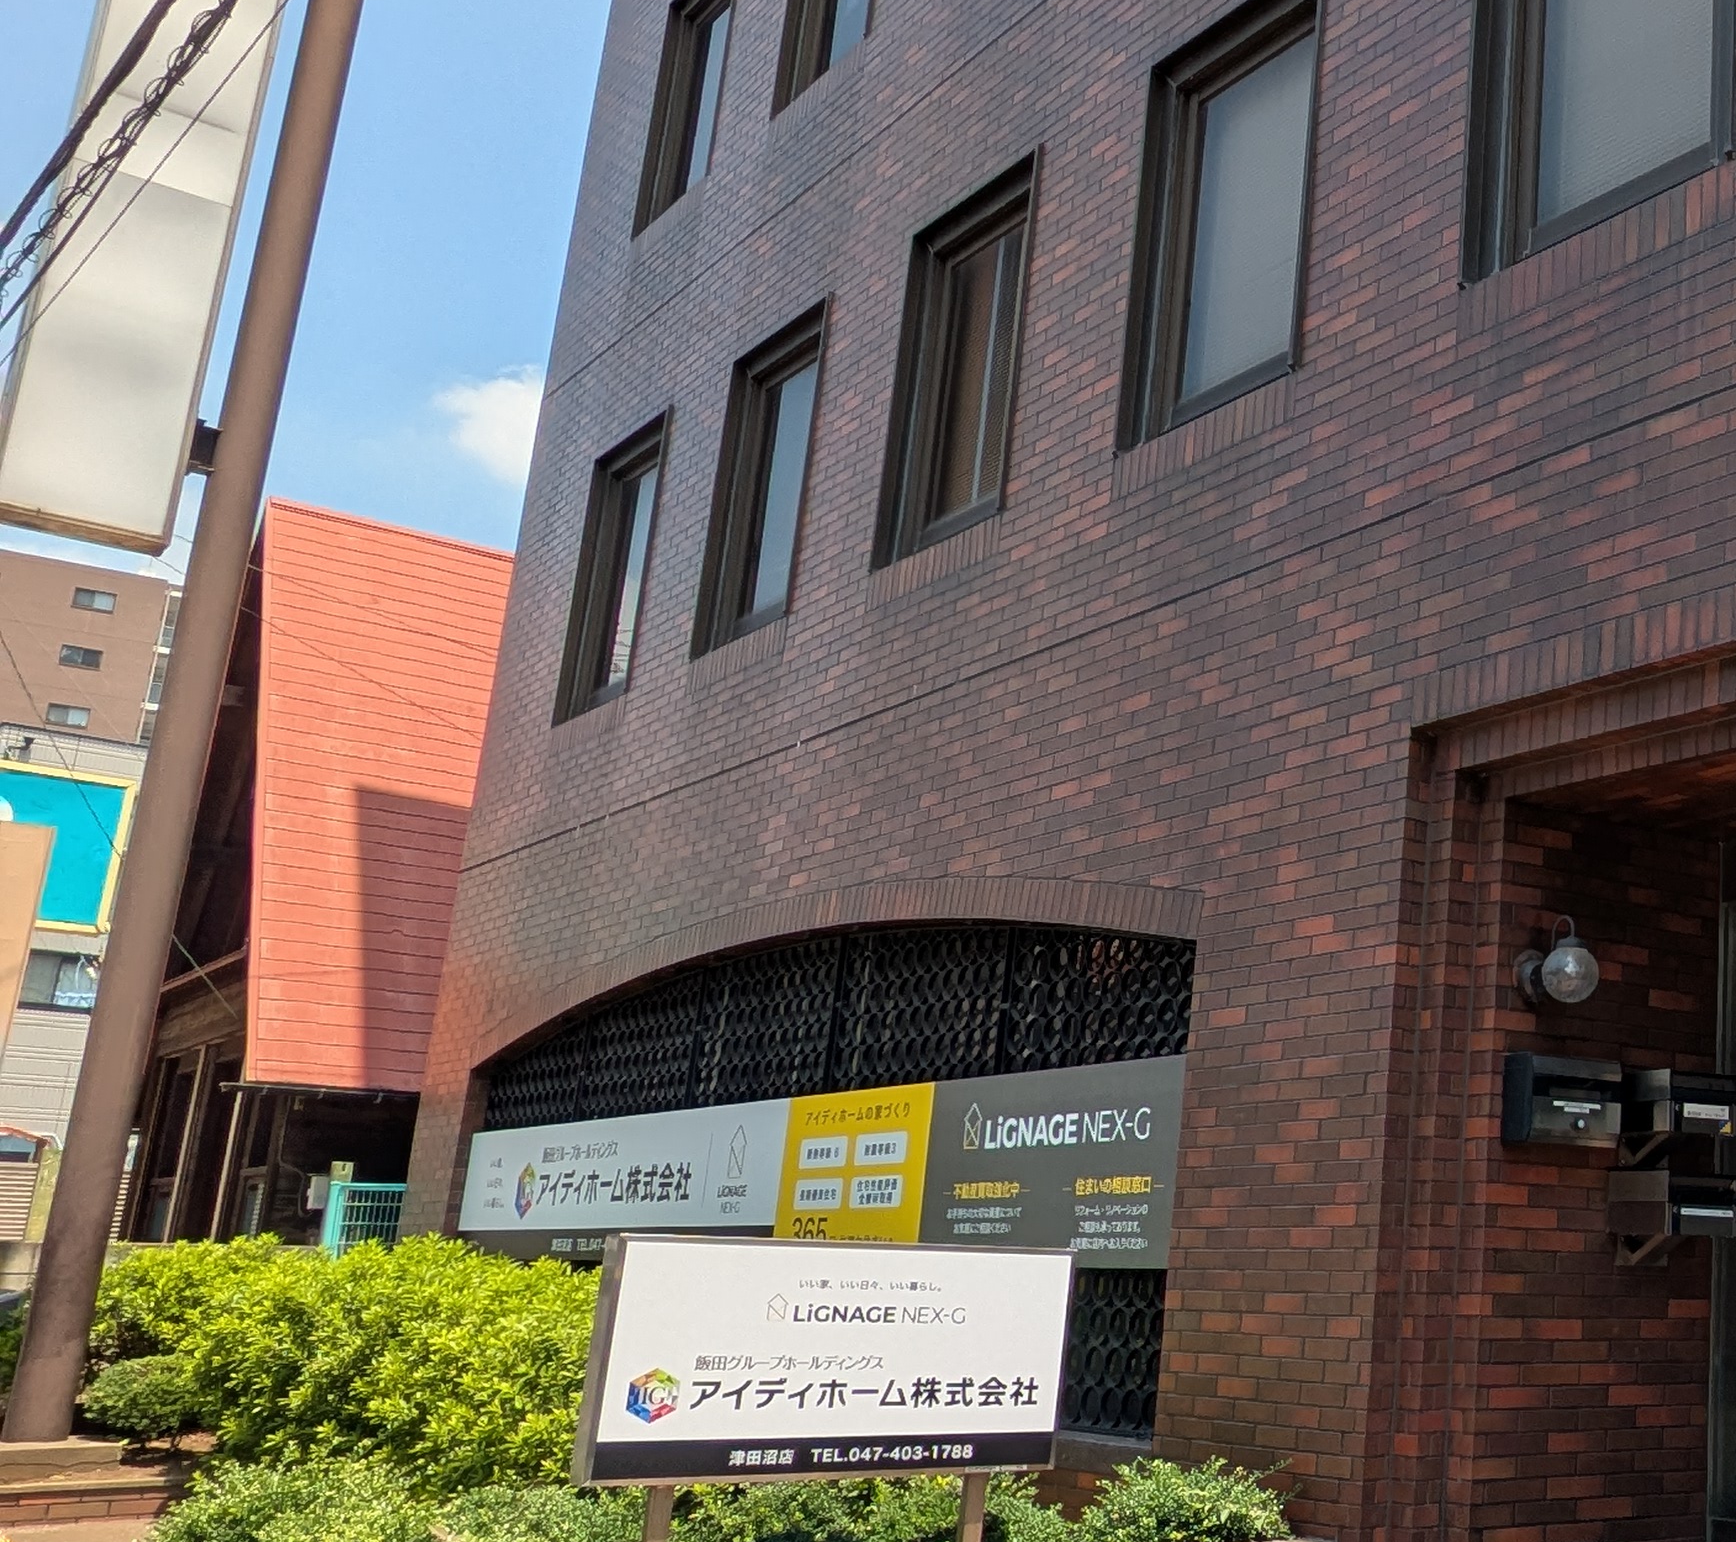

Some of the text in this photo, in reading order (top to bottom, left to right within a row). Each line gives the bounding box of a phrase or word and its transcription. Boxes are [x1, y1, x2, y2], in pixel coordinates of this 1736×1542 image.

[984, 1107, 1151, 1149] LiGNAGE NEX-G
[535, 1161, 692, 1206] アイディホーム株式会社
[793, 1303, 966, 1325] LiGNAGE NEX-G
[694, 1355, 884, 1373] 飯田グループホールディングス
[689, 1376, 1039, 1411] アイディホーム株式会社
[728, 1444, 974, 1468] 津田沼店 TEL.047-403-1788
